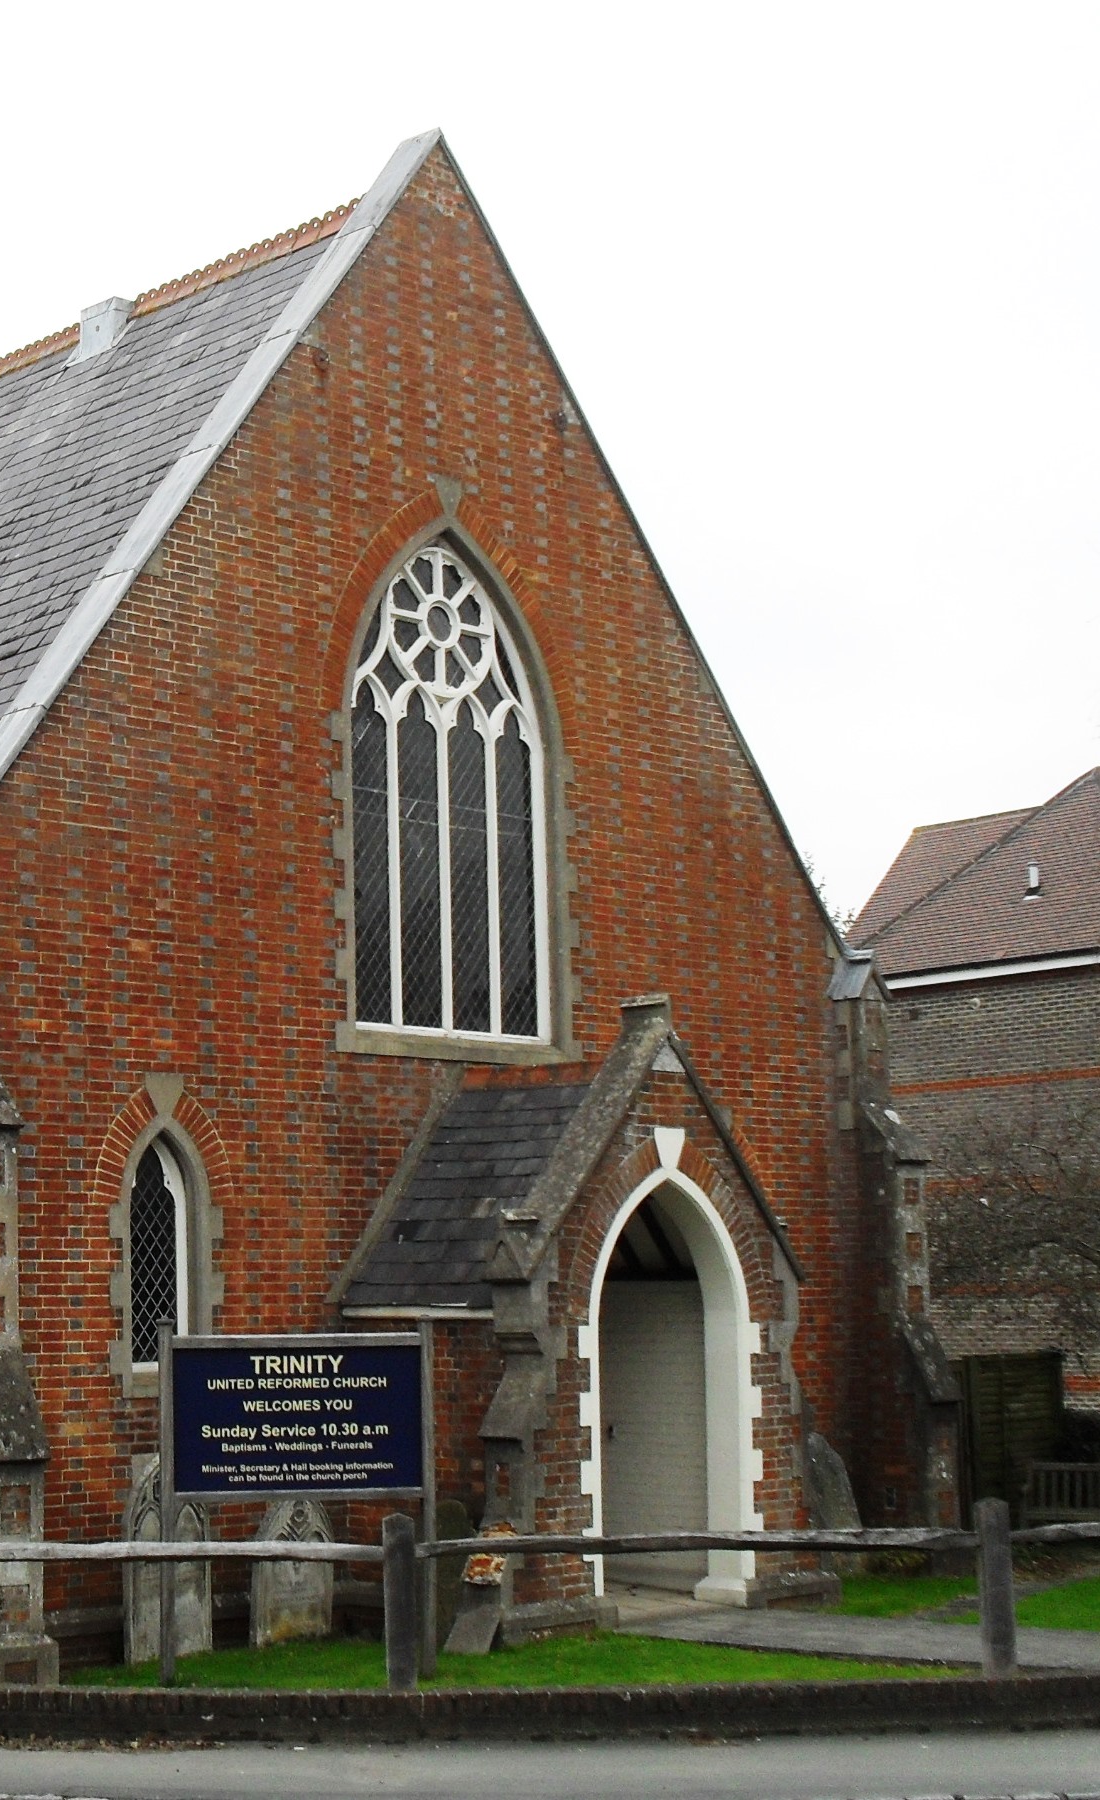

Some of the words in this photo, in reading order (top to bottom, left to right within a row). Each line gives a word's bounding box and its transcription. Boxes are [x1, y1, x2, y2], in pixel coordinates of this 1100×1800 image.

[250, 1355, 343, 1374] TRINITY
[208, 1379, 254, 1390] UNITED
[258, 1378, 329, 1389] REFORMED
[333, 1377, 386, 1388] CHURCH
[243, 1400, 320, 1411] WELCOMES
[324, 1399, 352, 1410] YOU
[202, 1425, 257, 1440] Sunday
[262, 1424, 316, 1437] Service
[321, 1423, 358, 1435] 10.30
[363, 1425, 388, 1435] a.m
[222, 1443, 267, 1453] Baptisms
[275, 1442, 323, 1452] Weddings
[331, 1441, 373, 1449] Funerals
[202, 1465, 237, 1473] Minister,
[240, 1464, 280, 1473] Secretary
[291, 1463, 307, 1471] Hall
[309, 1463, 343, 1472] booking
[346, 1462, 393, 1470] information
[259, 1473, 283, 1481] found
[311, 1472, 341, 1480] church
[343, 1471, 367, 1481] porch
